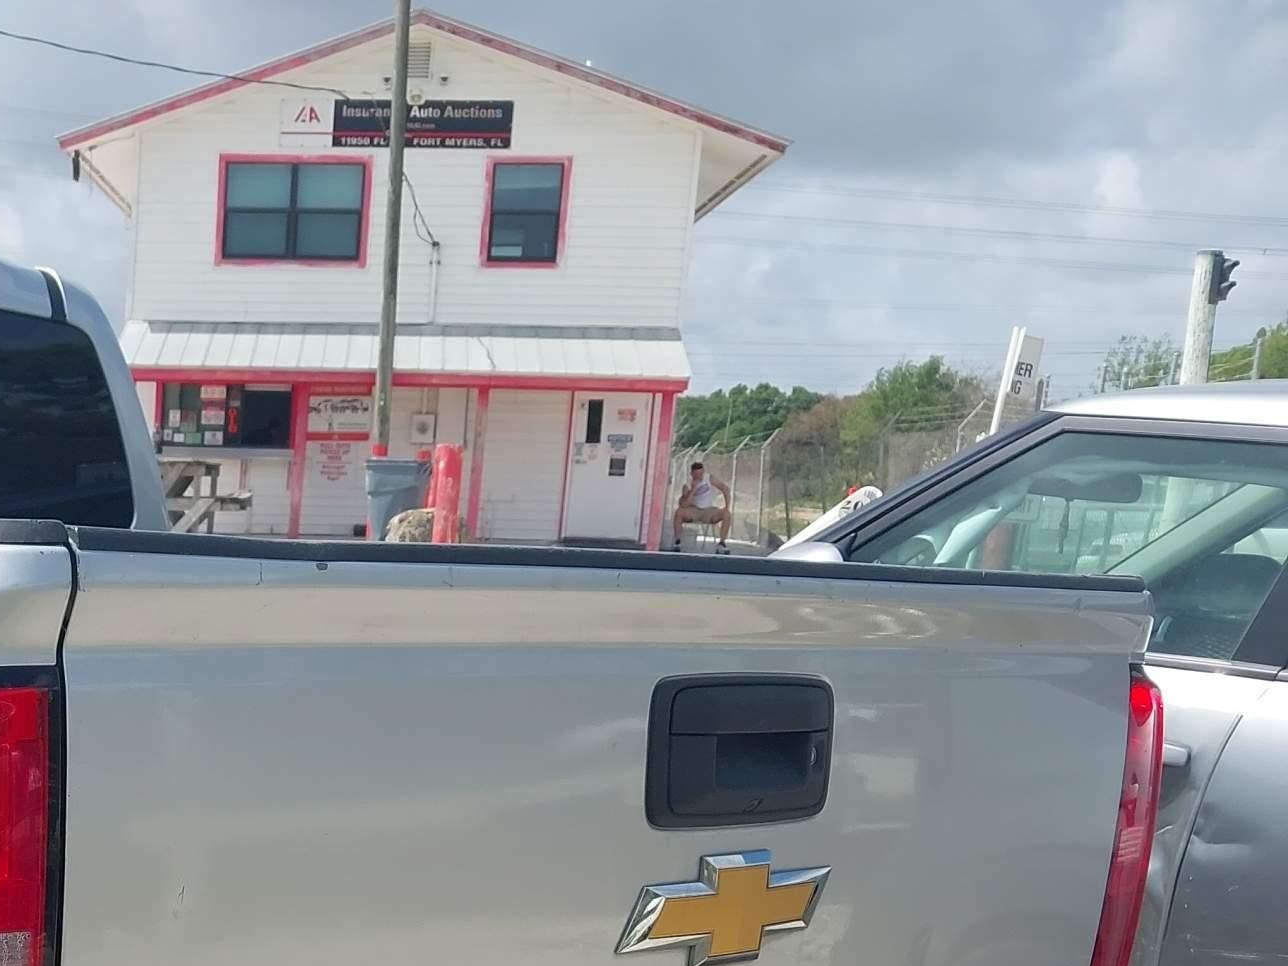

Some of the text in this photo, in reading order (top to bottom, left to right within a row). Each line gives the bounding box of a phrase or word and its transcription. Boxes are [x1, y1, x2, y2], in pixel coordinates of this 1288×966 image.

[342, 104, 503, 118] Insuran Auto Auctions
[412, 137, 442, 146] FORT
[490, 138, 503, 146] FL
